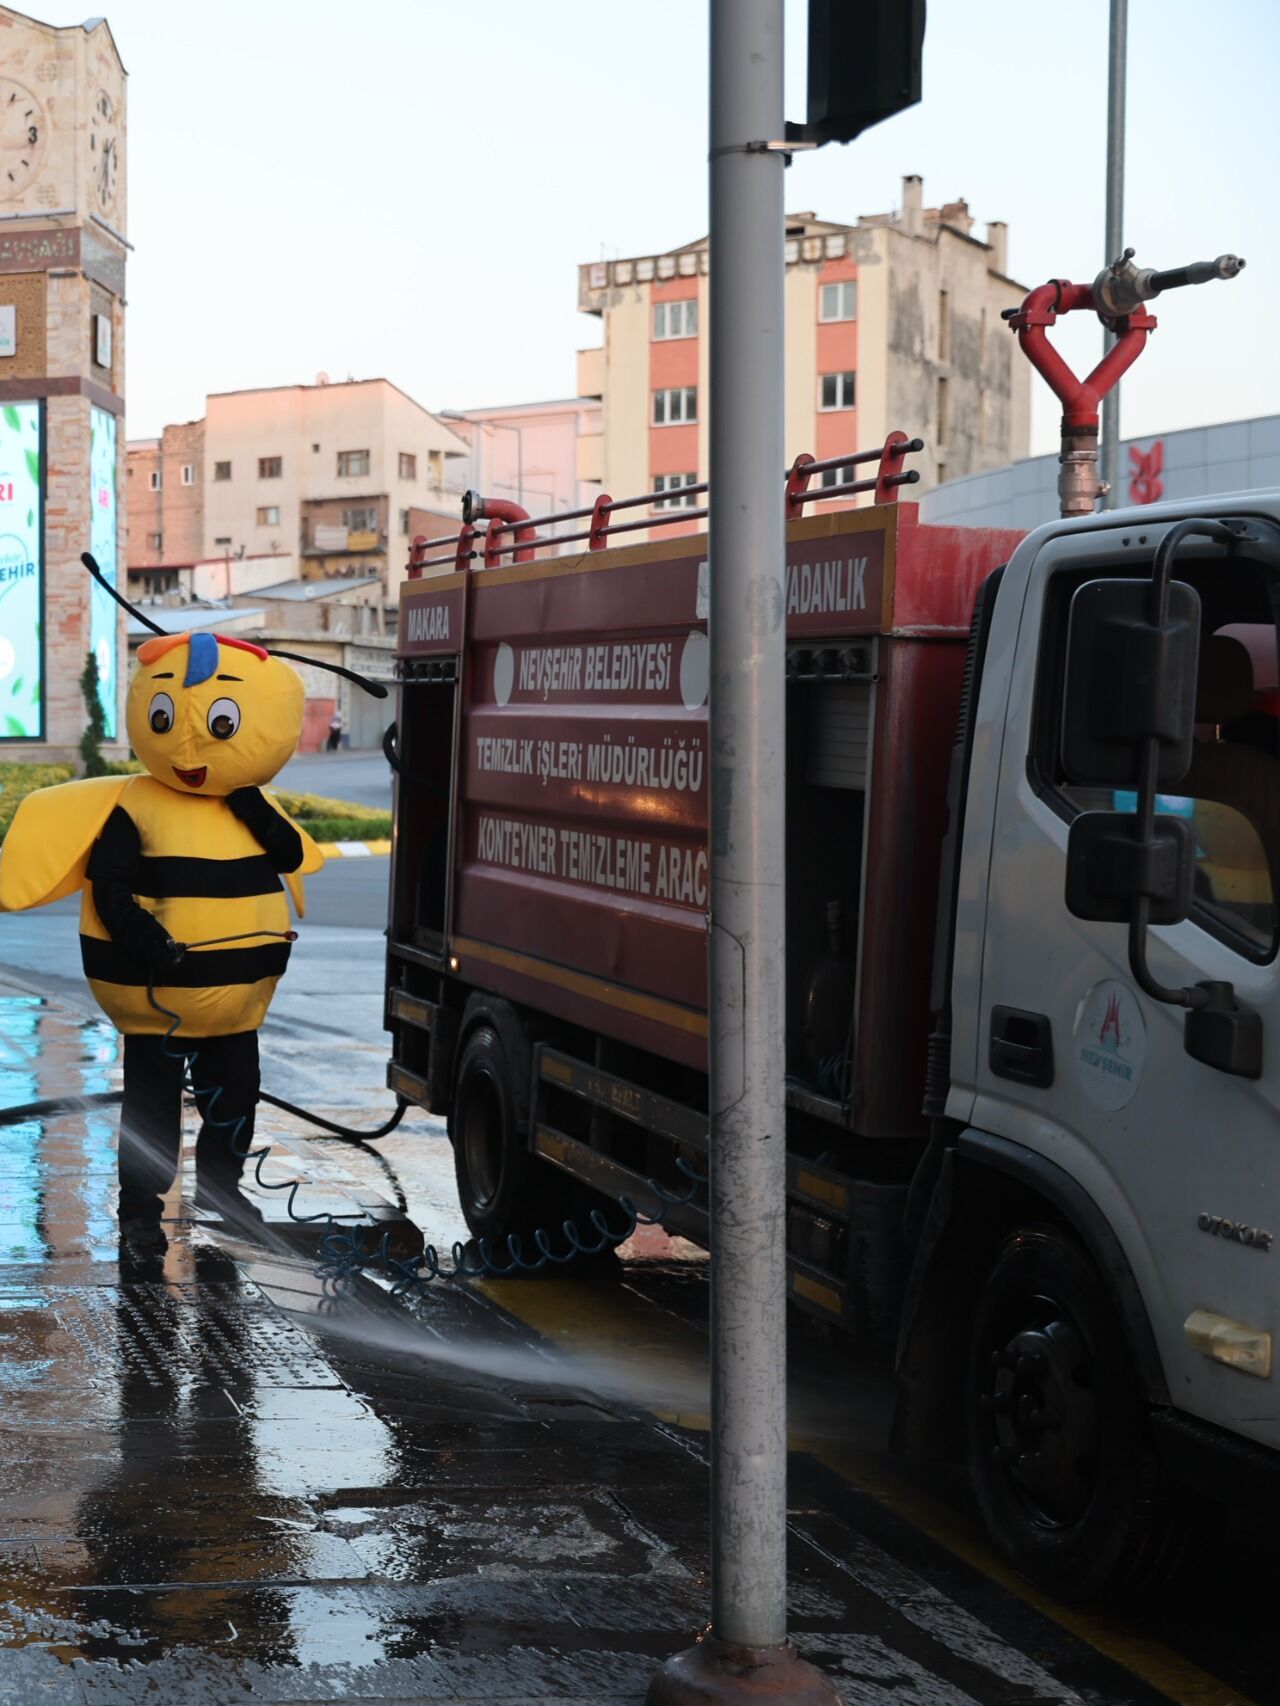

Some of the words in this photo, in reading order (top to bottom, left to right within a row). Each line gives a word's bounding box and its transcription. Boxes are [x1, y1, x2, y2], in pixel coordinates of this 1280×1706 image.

[28, 126, 38, 144] 3
[785, 557, 869, 616] ADANLIK
[407, 605, 450, 643] MAKARA
[587, 733, 704, 791] MÜDÜRLÜĞÜ
[478, 816, 557, 875] KONTEYNER
[655, 845, 709, 906] ARAC
